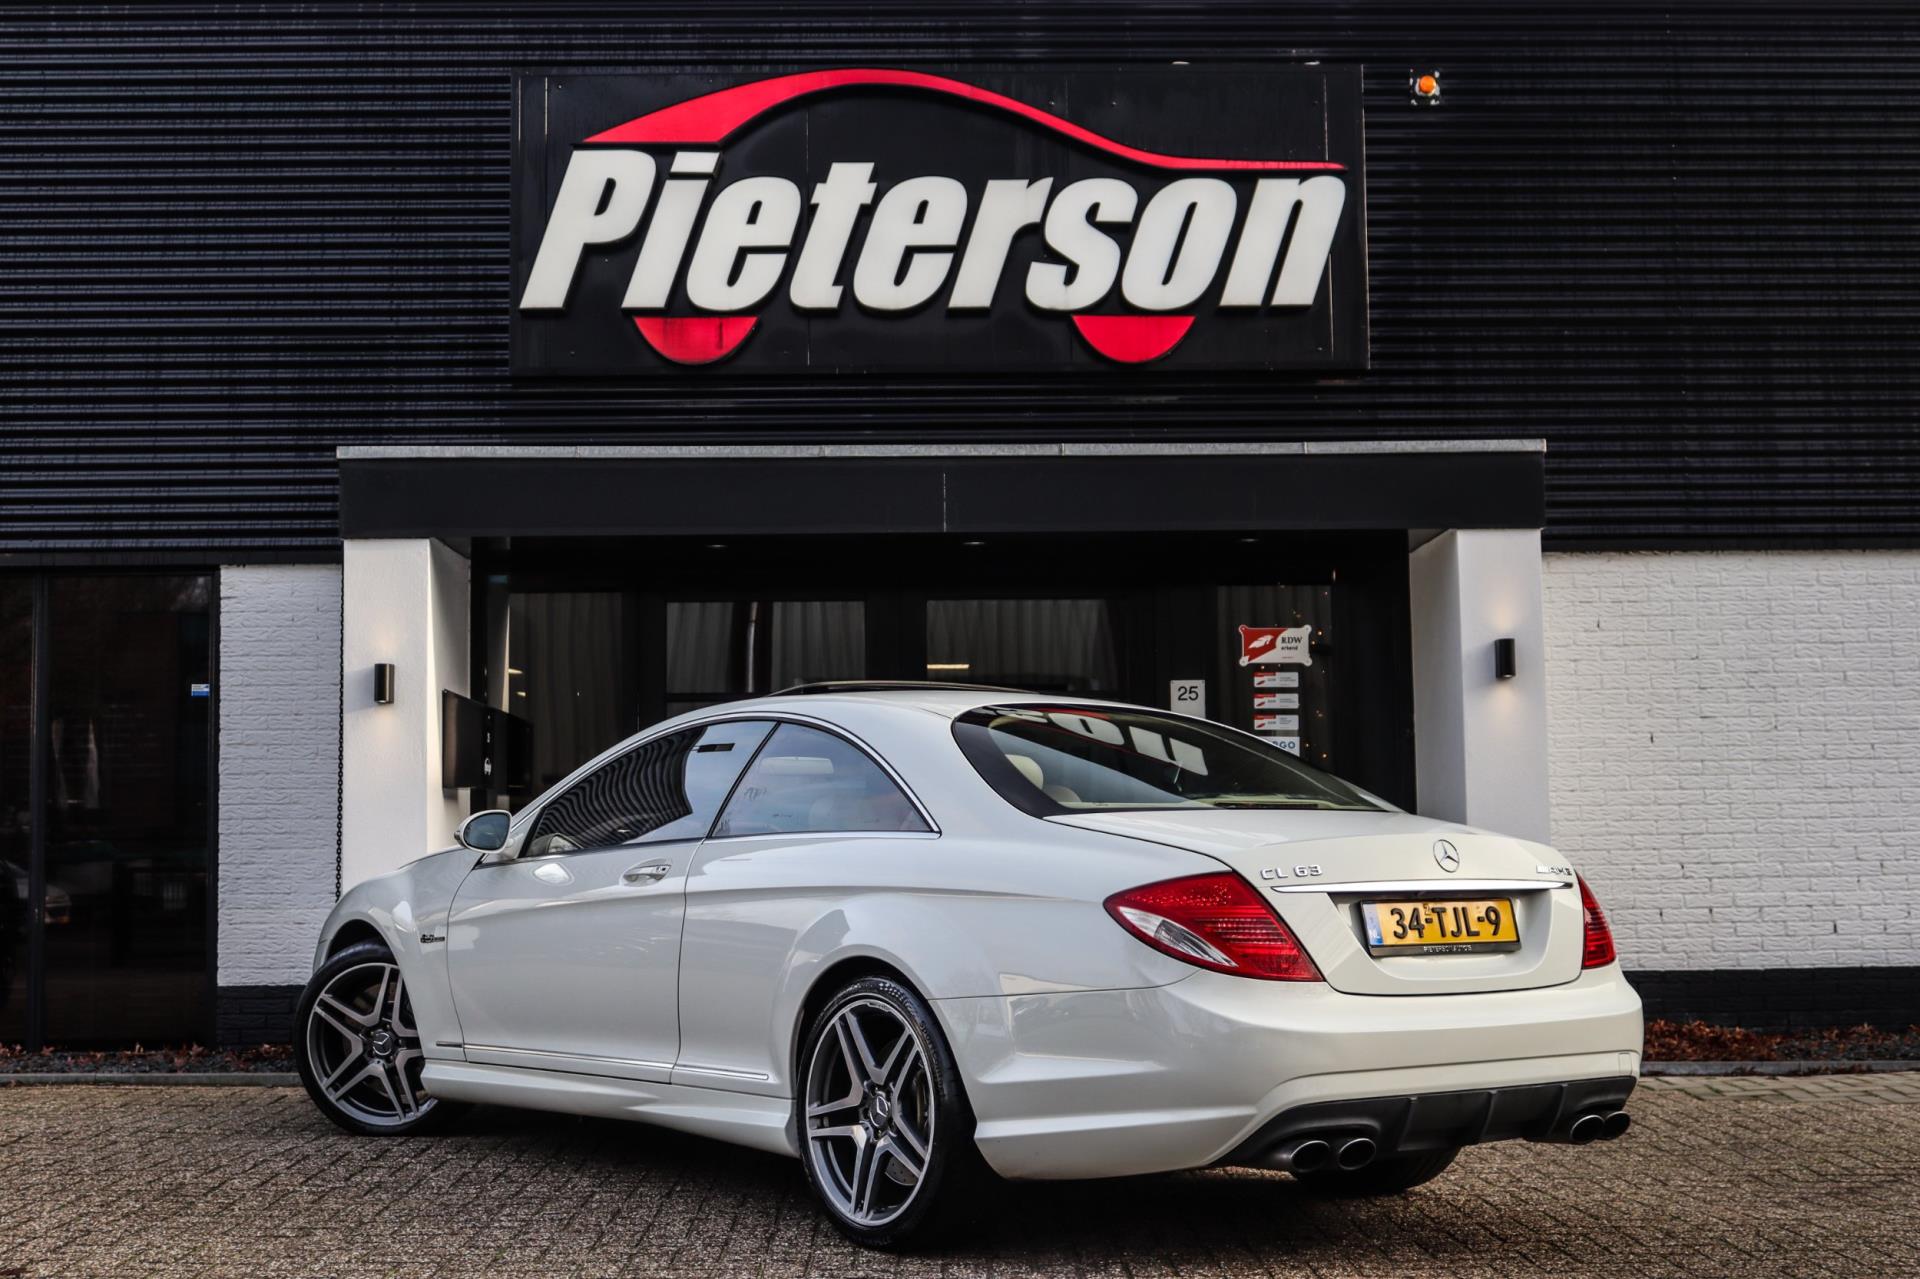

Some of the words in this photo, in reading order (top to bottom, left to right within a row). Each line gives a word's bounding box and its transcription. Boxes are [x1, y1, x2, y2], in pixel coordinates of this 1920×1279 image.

[519, 148, 1347, 313] Pieterson
[1281, 636, 1302, 644] RDW
[1177, 686, 1199, 701] 25
[1260, 867, 1289, 880] CL
[1293, 864, 1323, 877] 63
[1390, 905, 1501, 940] 34-TJL-9
